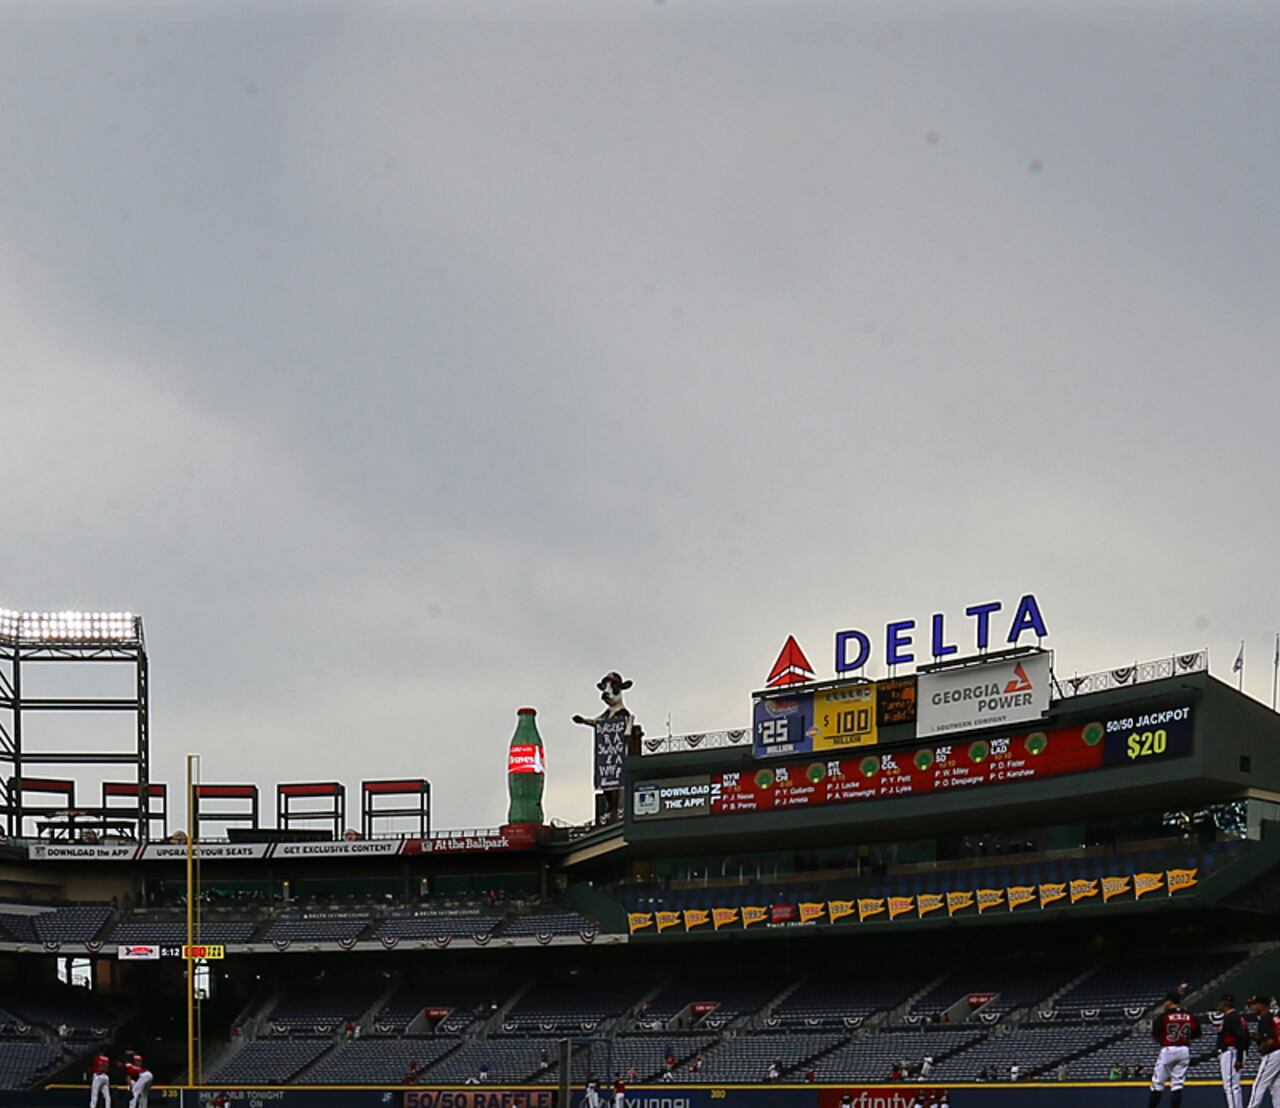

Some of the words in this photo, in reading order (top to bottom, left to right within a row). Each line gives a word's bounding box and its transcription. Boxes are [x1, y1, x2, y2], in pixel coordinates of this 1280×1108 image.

[835, 594, 1048, 674] DELTA
[932, 683, 1001, 705] GEORGIA
[978, 694, 1033, 713] POWER
[1106, 719, 1134, 733] 50/50
[1135, 706, 1190, 728] JACKPOT
[1126, 729, 1168, 760] $20
[660, 785, 710, 798] DOWNLOAD
[664, 799, 683, 809] THE
[284, 845, 301, 854] GET
[303, 844, 349, 854] EXCLUSIVE
[351, 843, 392, 853] CONTENT
[434, 838, 449, 850] At
[449, 838, 465, 850] the
[465, 835, 510, 851] Ballpark
[47, 848, 95, 856] DOWNLOAD
[97, 848, 109, 856] the
[111, 848, 129, 856] APP
[200, 848, 224, 856] YOUR
[225, 847, 254, 855] SEATS
[1166, 1023, 1192, 1043] 54
[246, 1091, 284, 1100] TONIGHT
